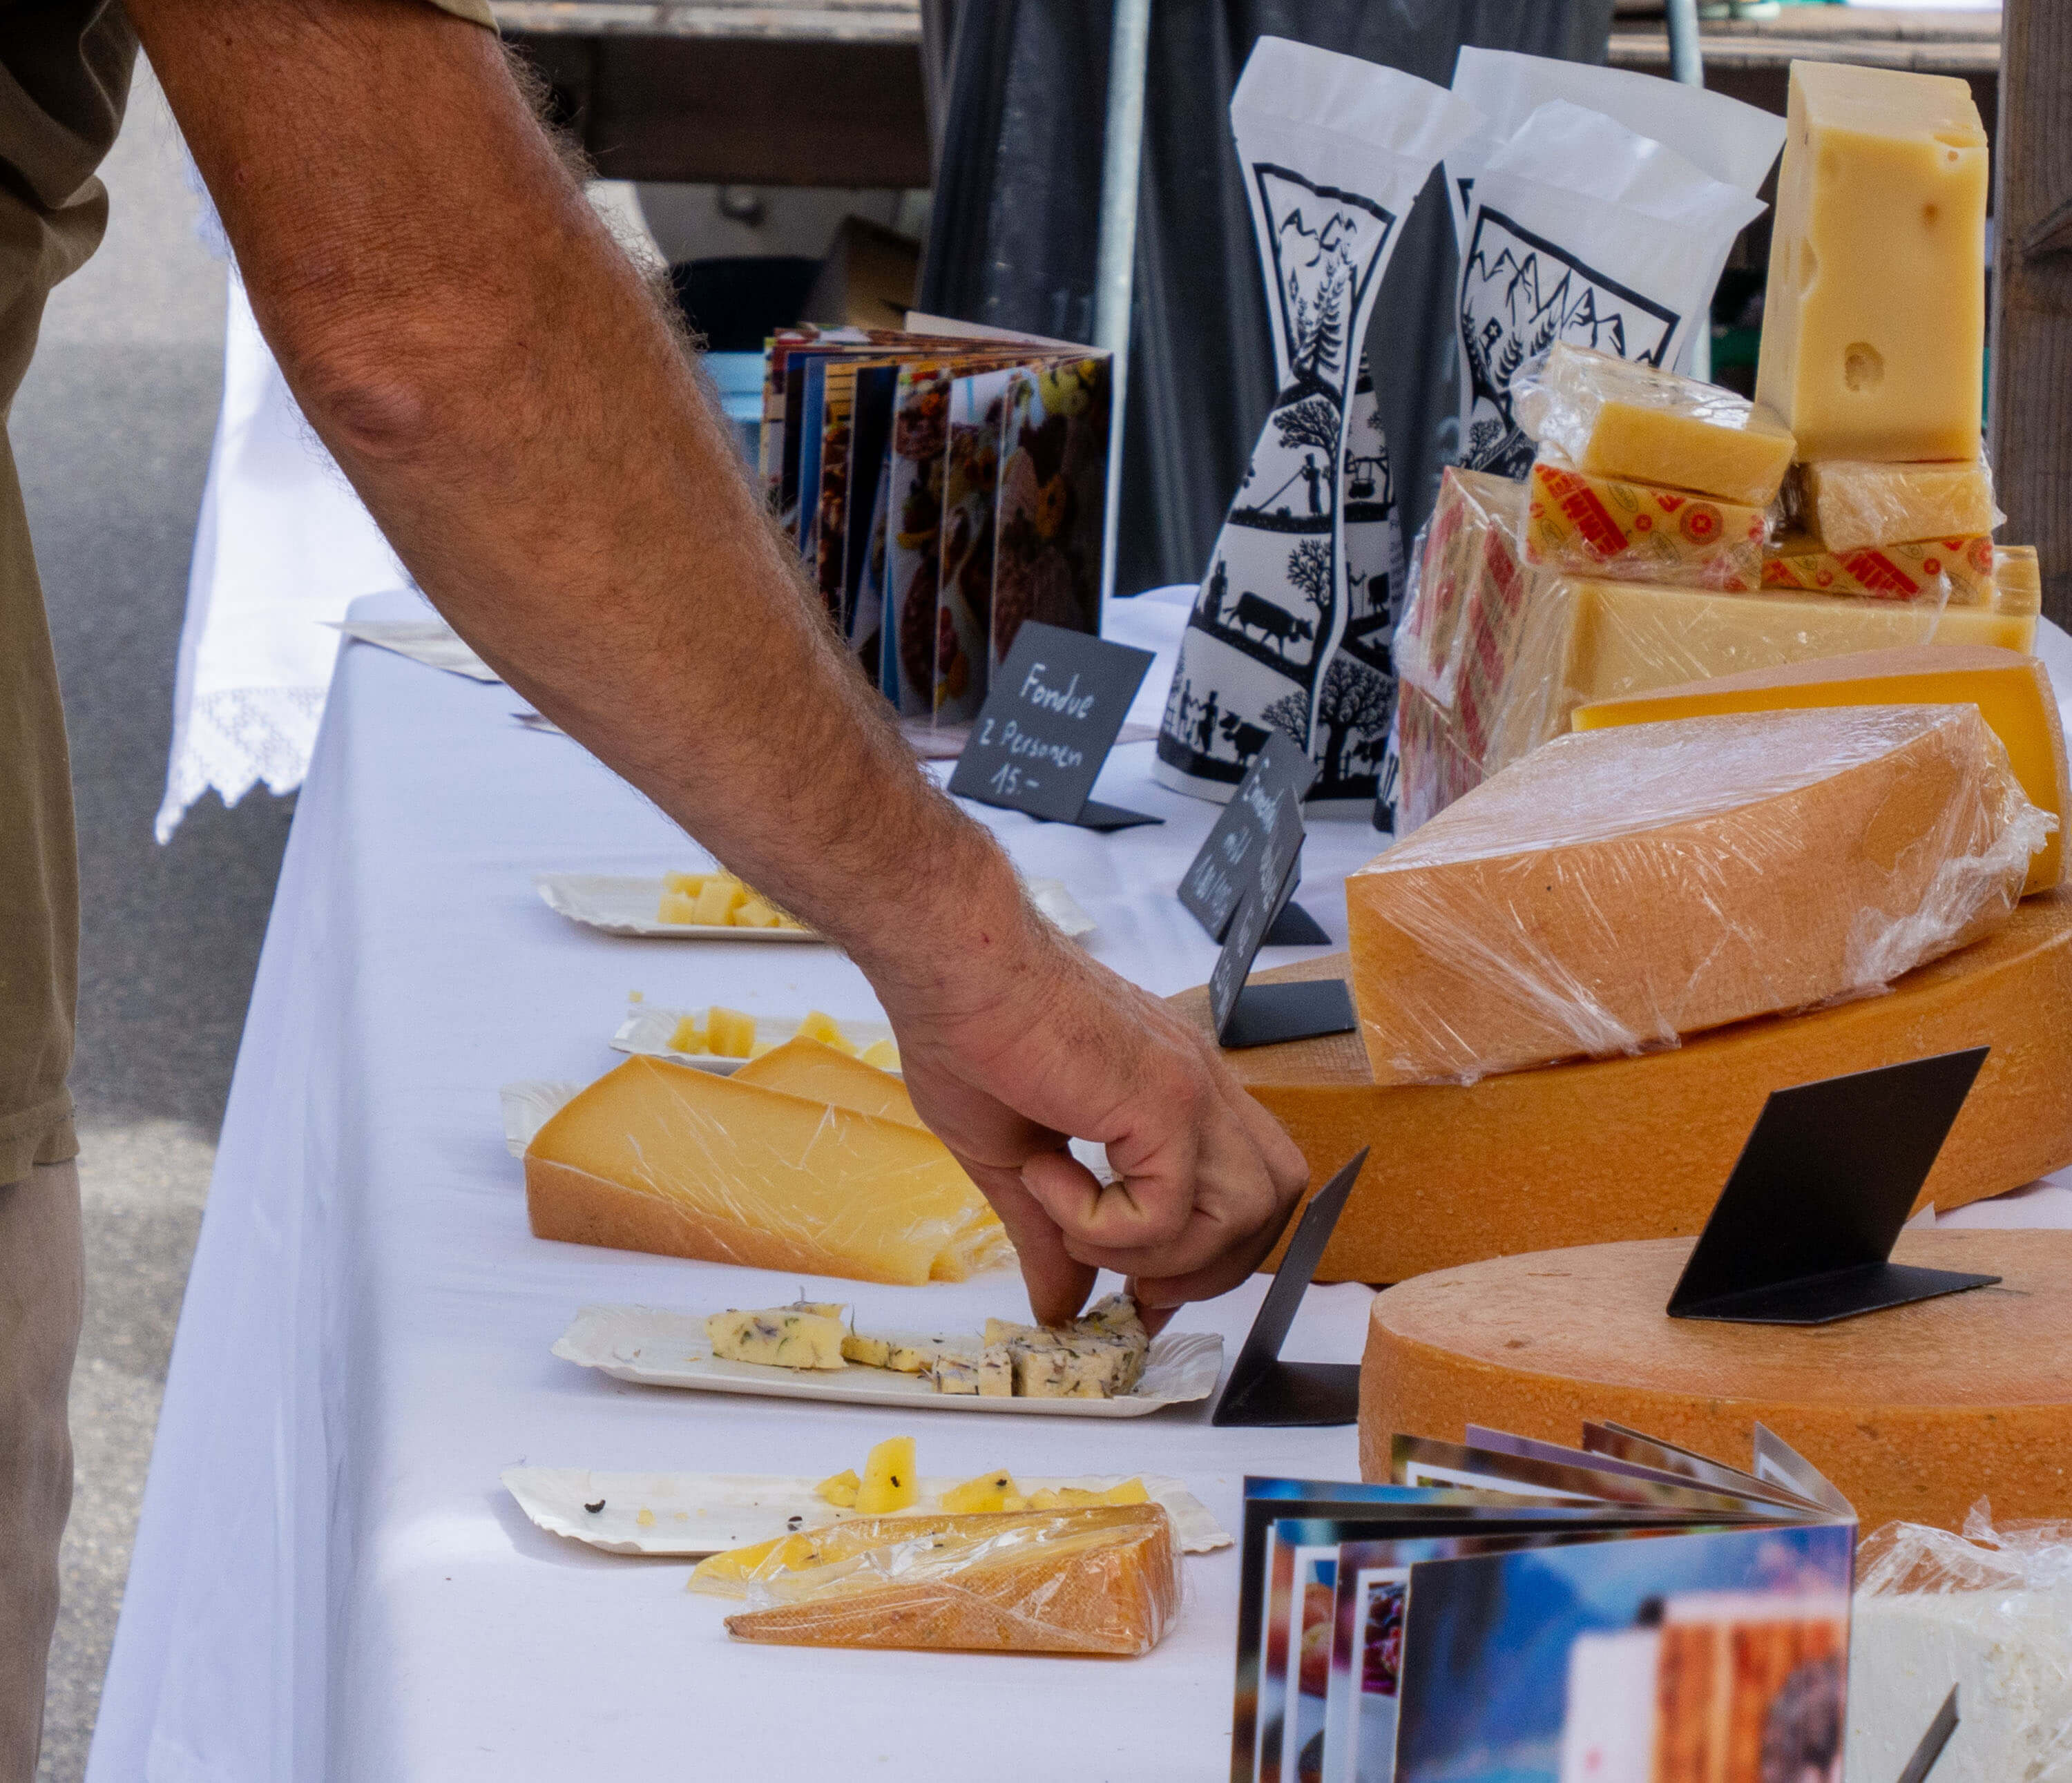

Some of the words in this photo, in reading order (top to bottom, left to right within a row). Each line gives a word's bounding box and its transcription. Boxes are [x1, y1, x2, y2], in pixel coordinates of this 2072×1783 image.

[1019, 662, 1095, 720] Fondue
[979, 718, 995, 746] 2
[1001, 720, 1083, 768] Personen
